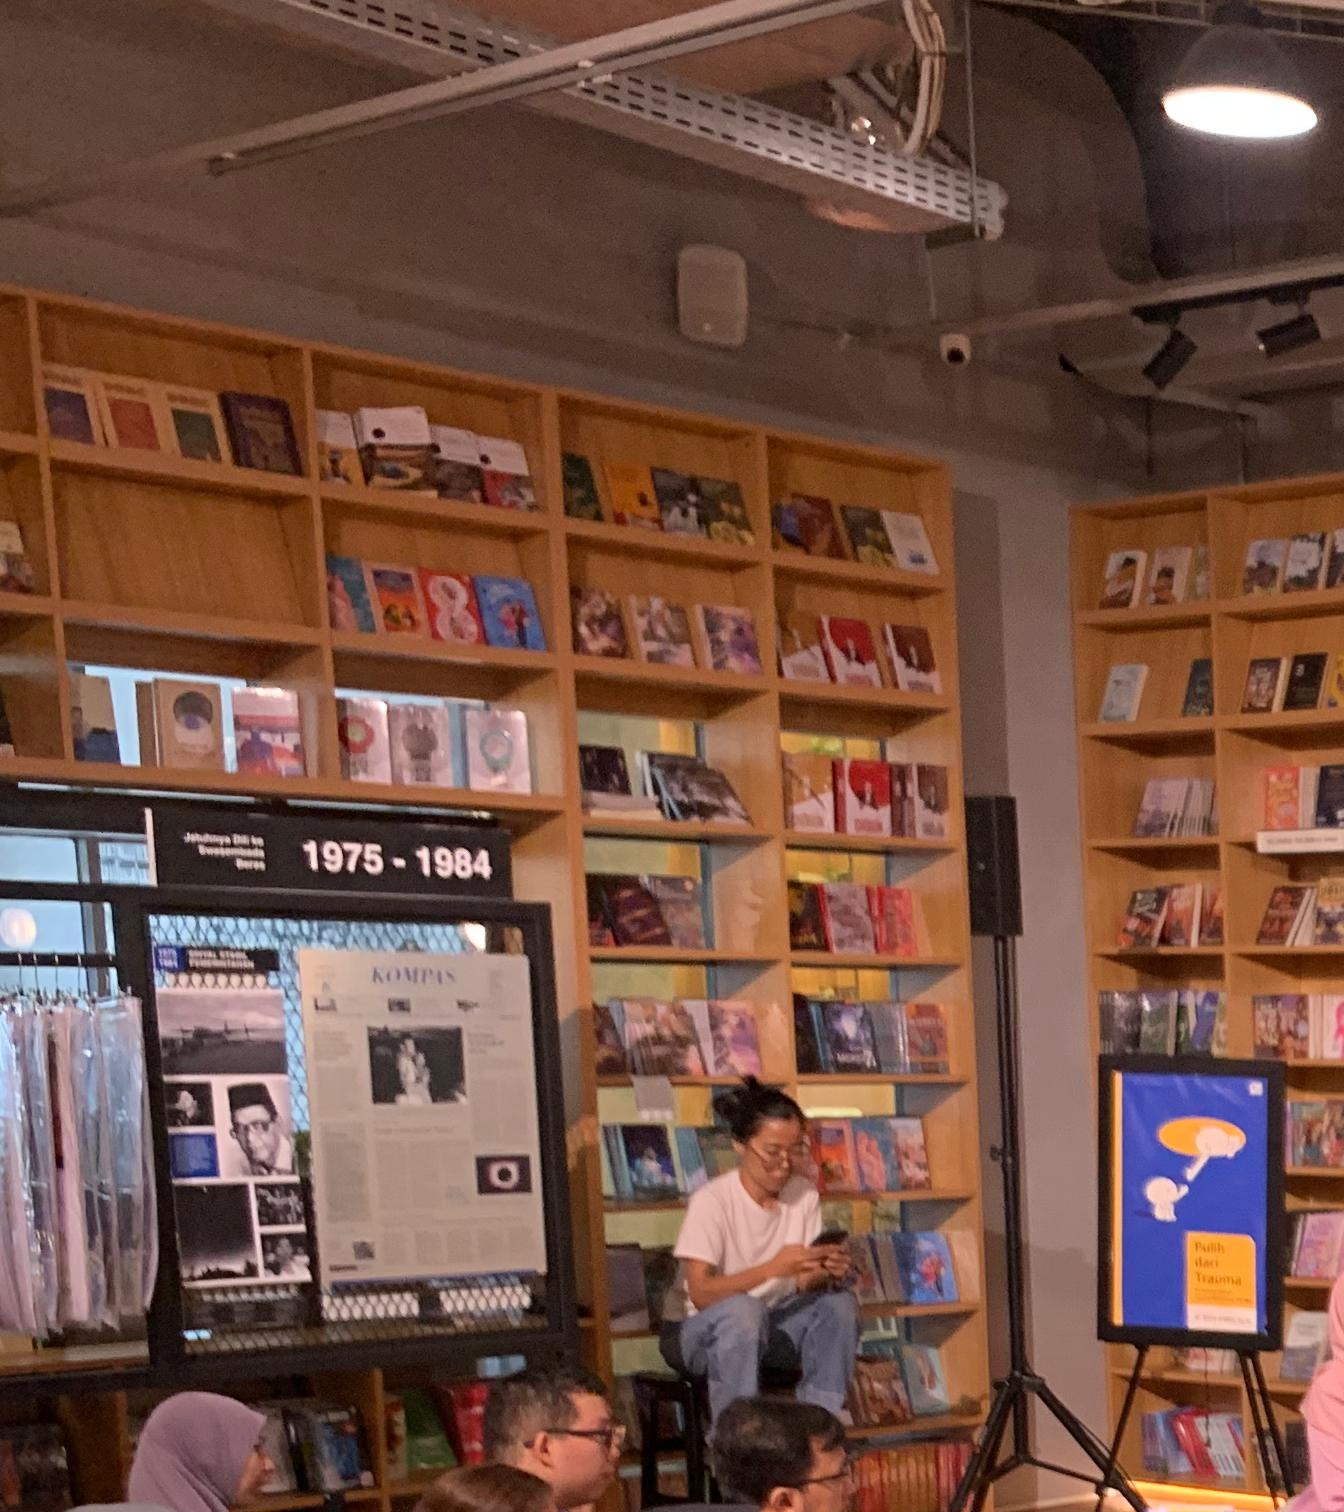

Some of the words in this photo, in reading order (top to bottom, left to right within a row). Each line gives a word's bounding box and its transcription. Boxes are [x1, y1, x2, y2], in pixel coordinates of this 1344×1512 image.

[302, 839, 385, 876] 1975
[392, 857, 407, 870] -
[415, 846, 493, 881] 1984
[372, 966, 456, 986] KOMPAS
